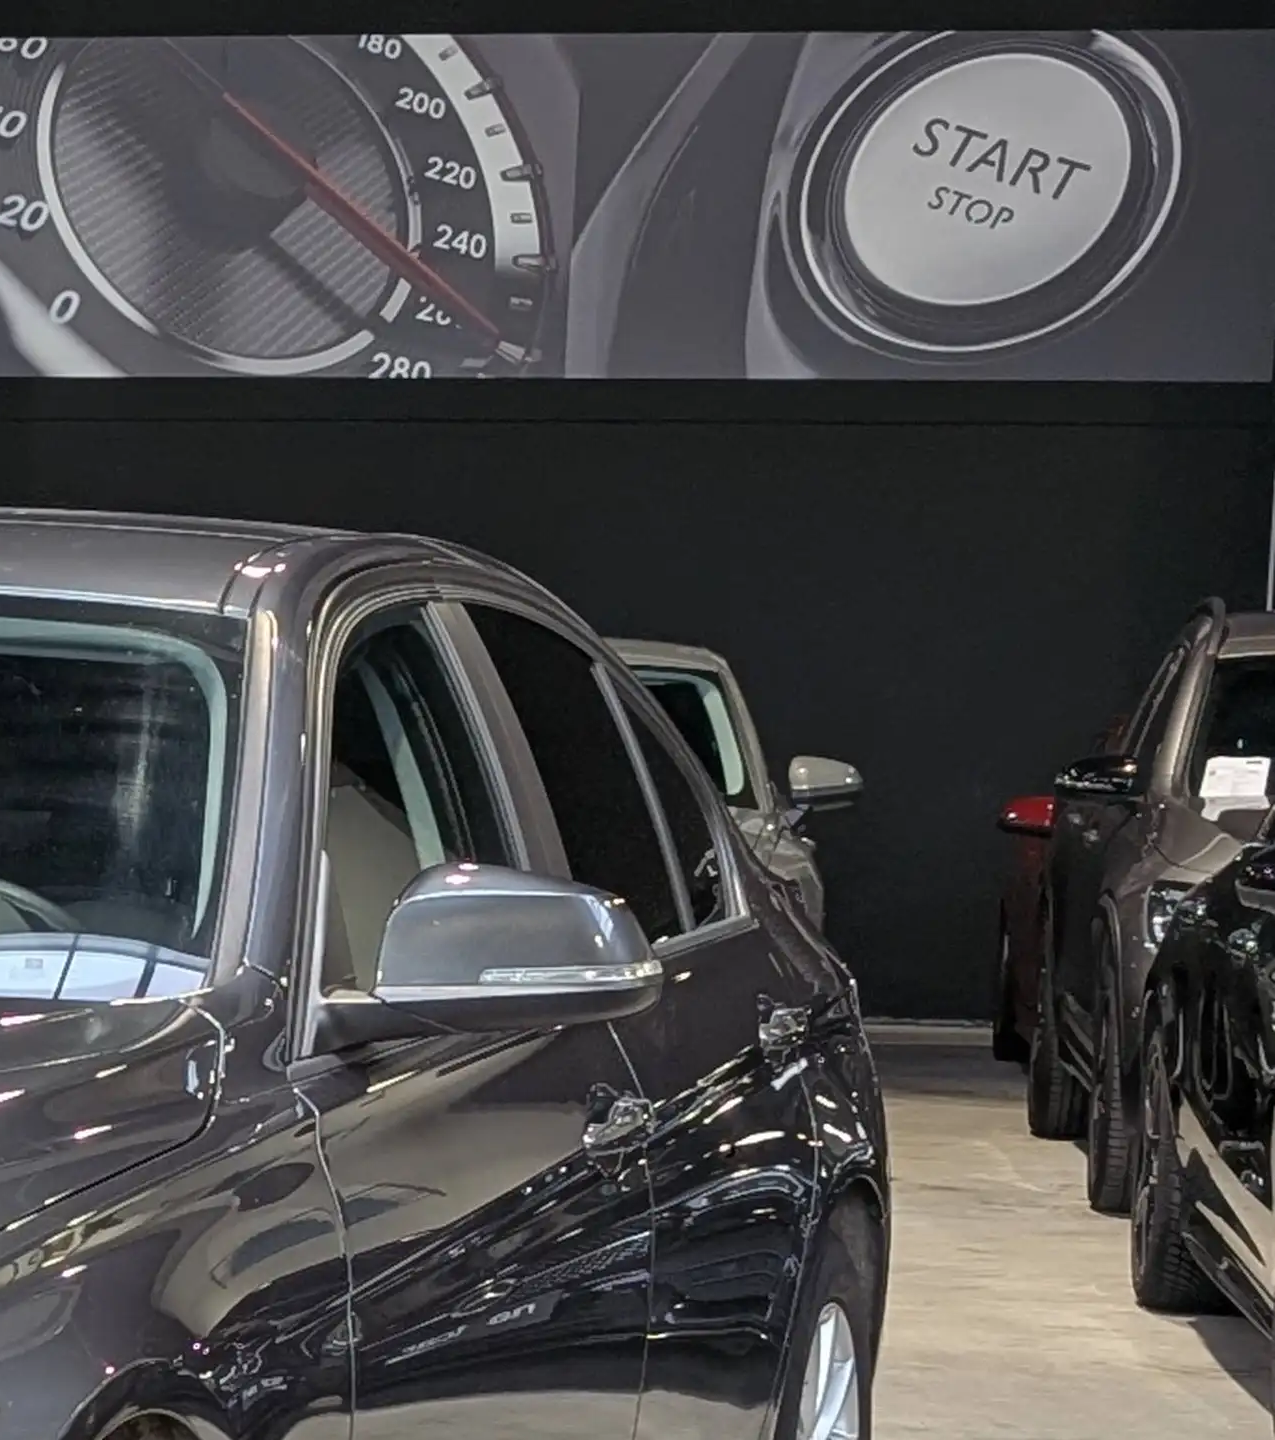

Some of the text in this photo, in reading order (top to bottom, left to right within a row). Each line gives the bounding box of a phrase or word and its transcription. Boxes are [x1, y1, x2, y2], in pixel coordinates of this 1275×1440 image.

[394, 87, 446, 119] 200
[424, 156, 476, 190] 220
[912, 118, 1092, 200] START
[927, 186, 1015, 229] STOP
[433, 224, 487, 258] 240
[50, 290, 81, 324] 0
